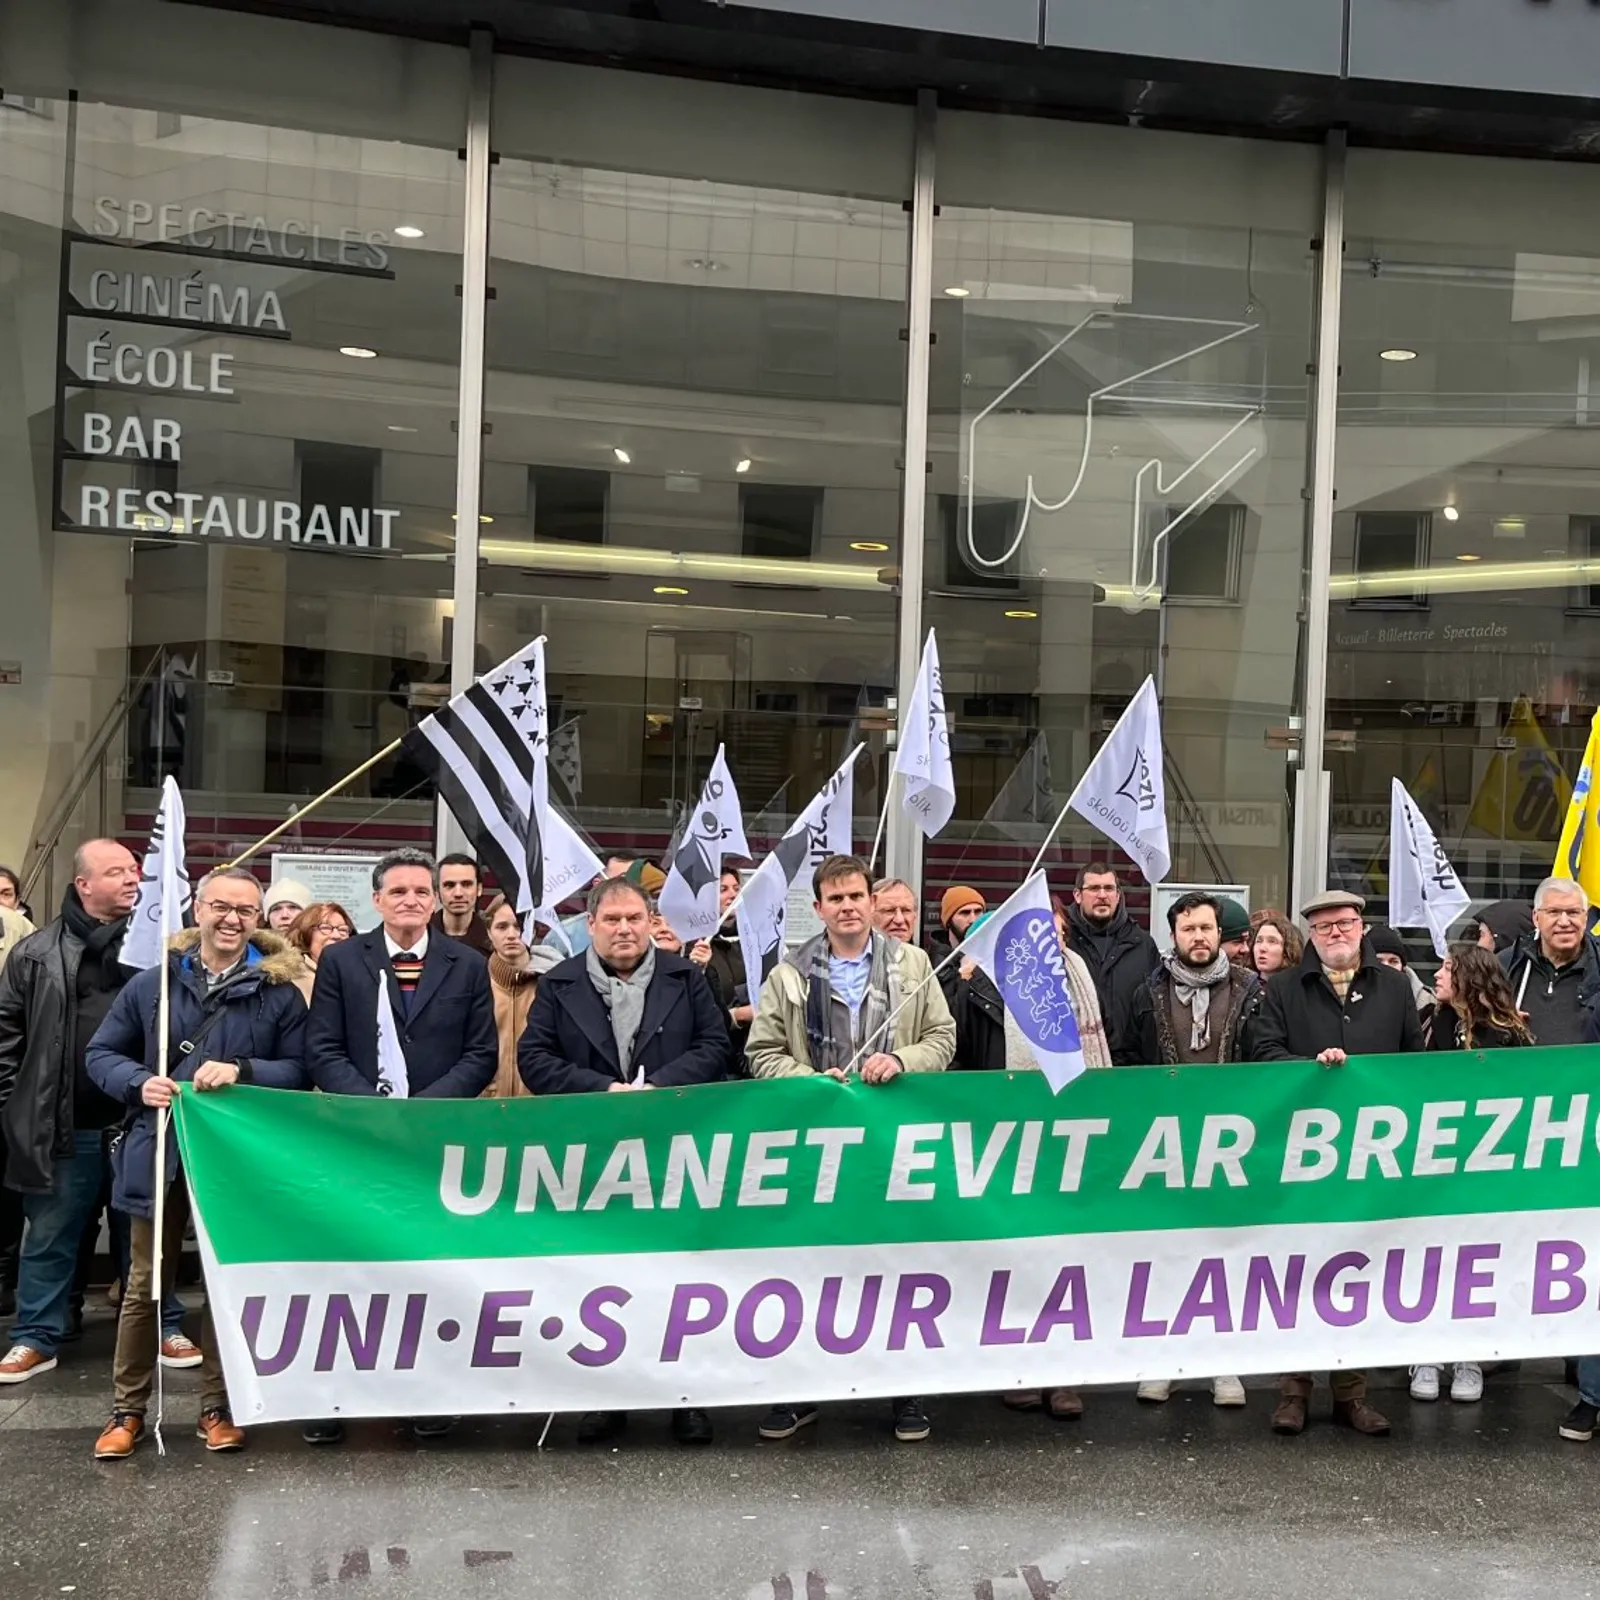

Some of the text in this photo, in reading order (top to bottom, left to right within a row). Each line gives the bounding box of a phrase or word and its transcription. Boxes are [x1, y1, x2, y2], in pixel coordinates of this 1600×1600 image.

[92, 196, 390, 271] SPECTACLES
[88, 269, 287, 331] CINÉMA
[84, 331, 235, 395] ÉCOLE
[82, 412, 182, 461] BAR
[80, 485, 400, 549] RESTAURANT
[1378, 626, 1435, 643] Billetterie
[1443, 621, 1508, 642] Spectacles
[439, 1093, 1600, 1216] UNANET EVIT AR BREZH
[659, 1273, 952, 1362] POUR
[979, 1265, 1093, 1346] LA
[1122, 1243, 1502, 1338] LANGUE
[1531, 1239, 1600, 1315] B
